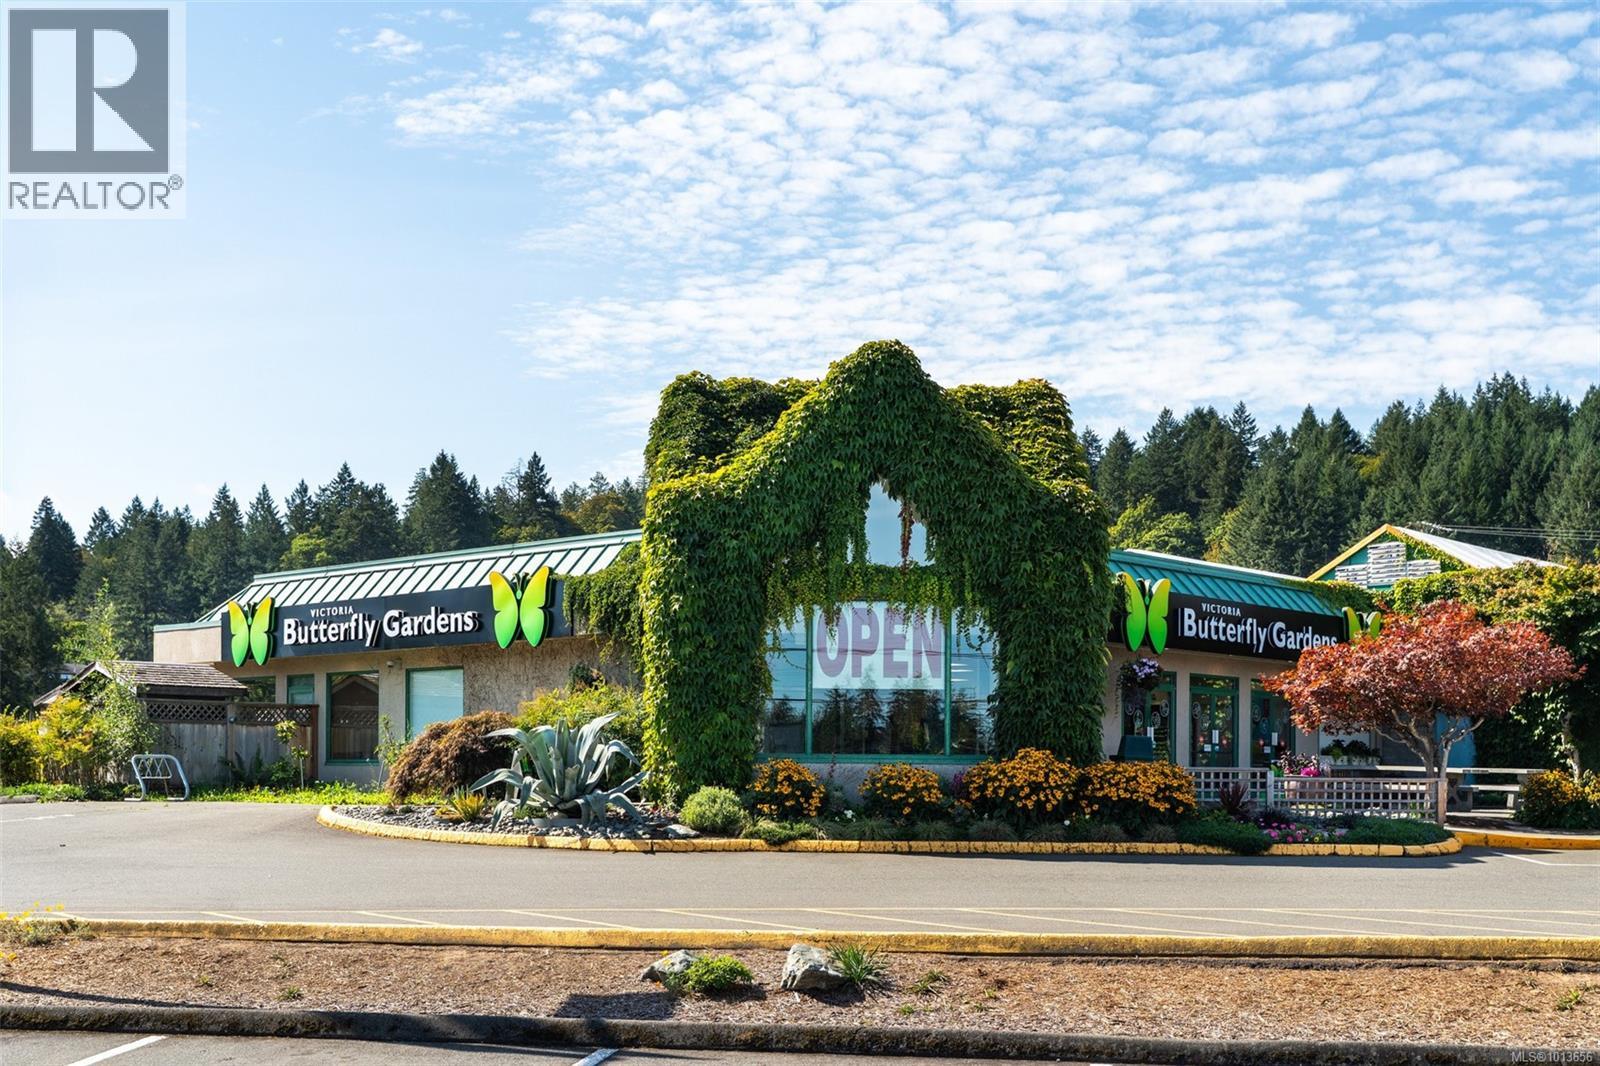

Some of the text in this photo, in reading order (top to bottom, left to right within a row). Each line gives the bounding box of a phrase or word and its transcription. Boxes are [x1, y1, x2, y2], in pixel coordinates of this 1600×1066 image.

[283, 606, 475, 647] Butterfly Gardens
[310, 605, 354, 618] VICTORIA
[1183, 607, 1268, 653] Butterfly
[1201, 602, 1241, 617] VICTORIA
[816, 606, 942, 679] OPEN
